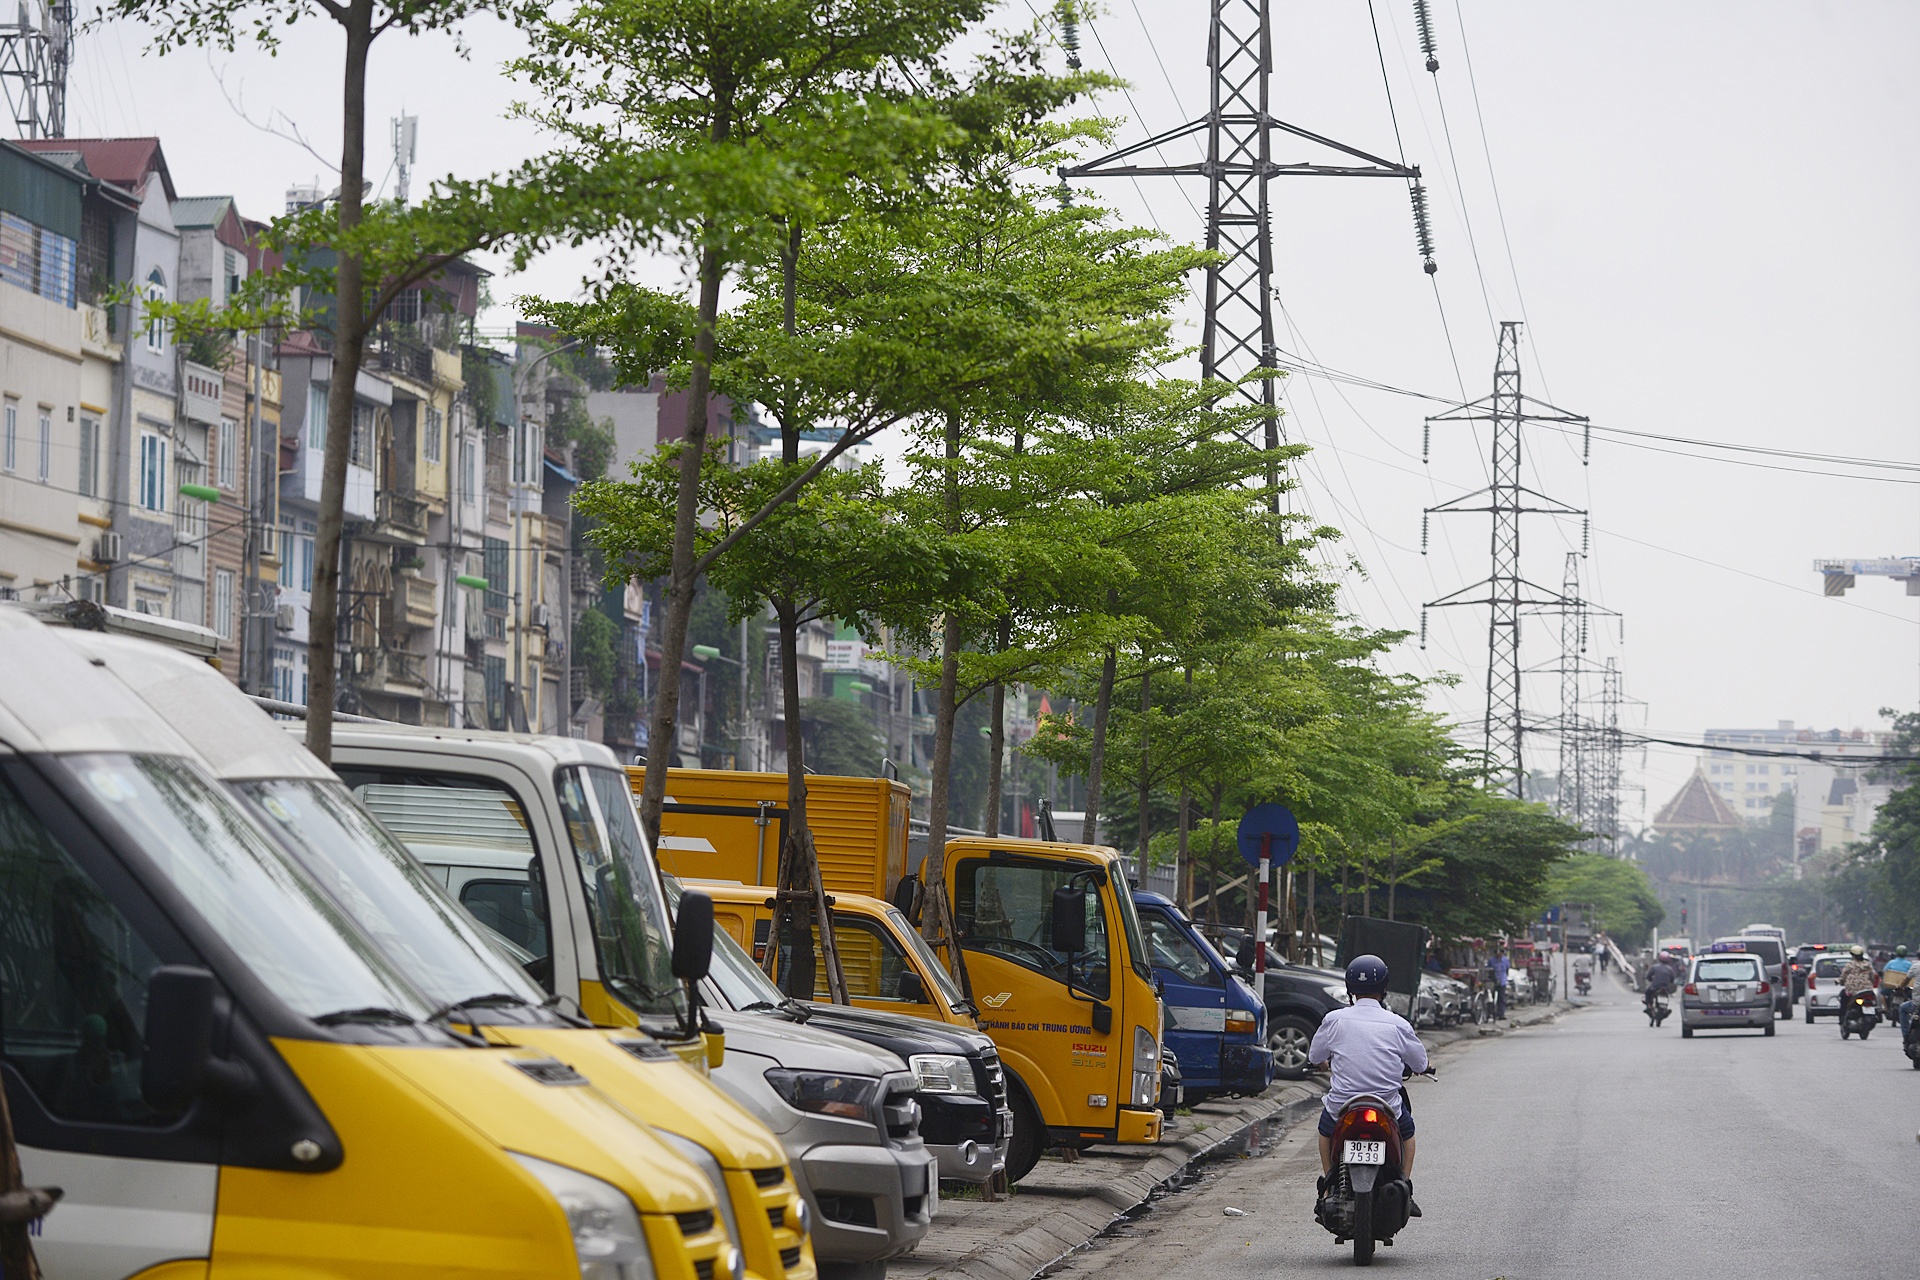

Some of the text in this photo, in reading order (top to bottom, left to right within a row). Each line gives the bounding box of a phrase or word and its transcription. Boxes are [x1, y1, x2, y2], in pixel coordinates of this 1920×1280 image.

[1011, 1020, 1026, 1031] BÁO
[1027, 1021, 1040, 1031] CHÍ
[1042, 1023, 1067, 1033] TRUNG
[1069, 1024, 1092, 1035] ƯƠNG
[1072, 1043, 1107, 1052] ISUZU
[1349, 1152, 1379, 1163] 7539
